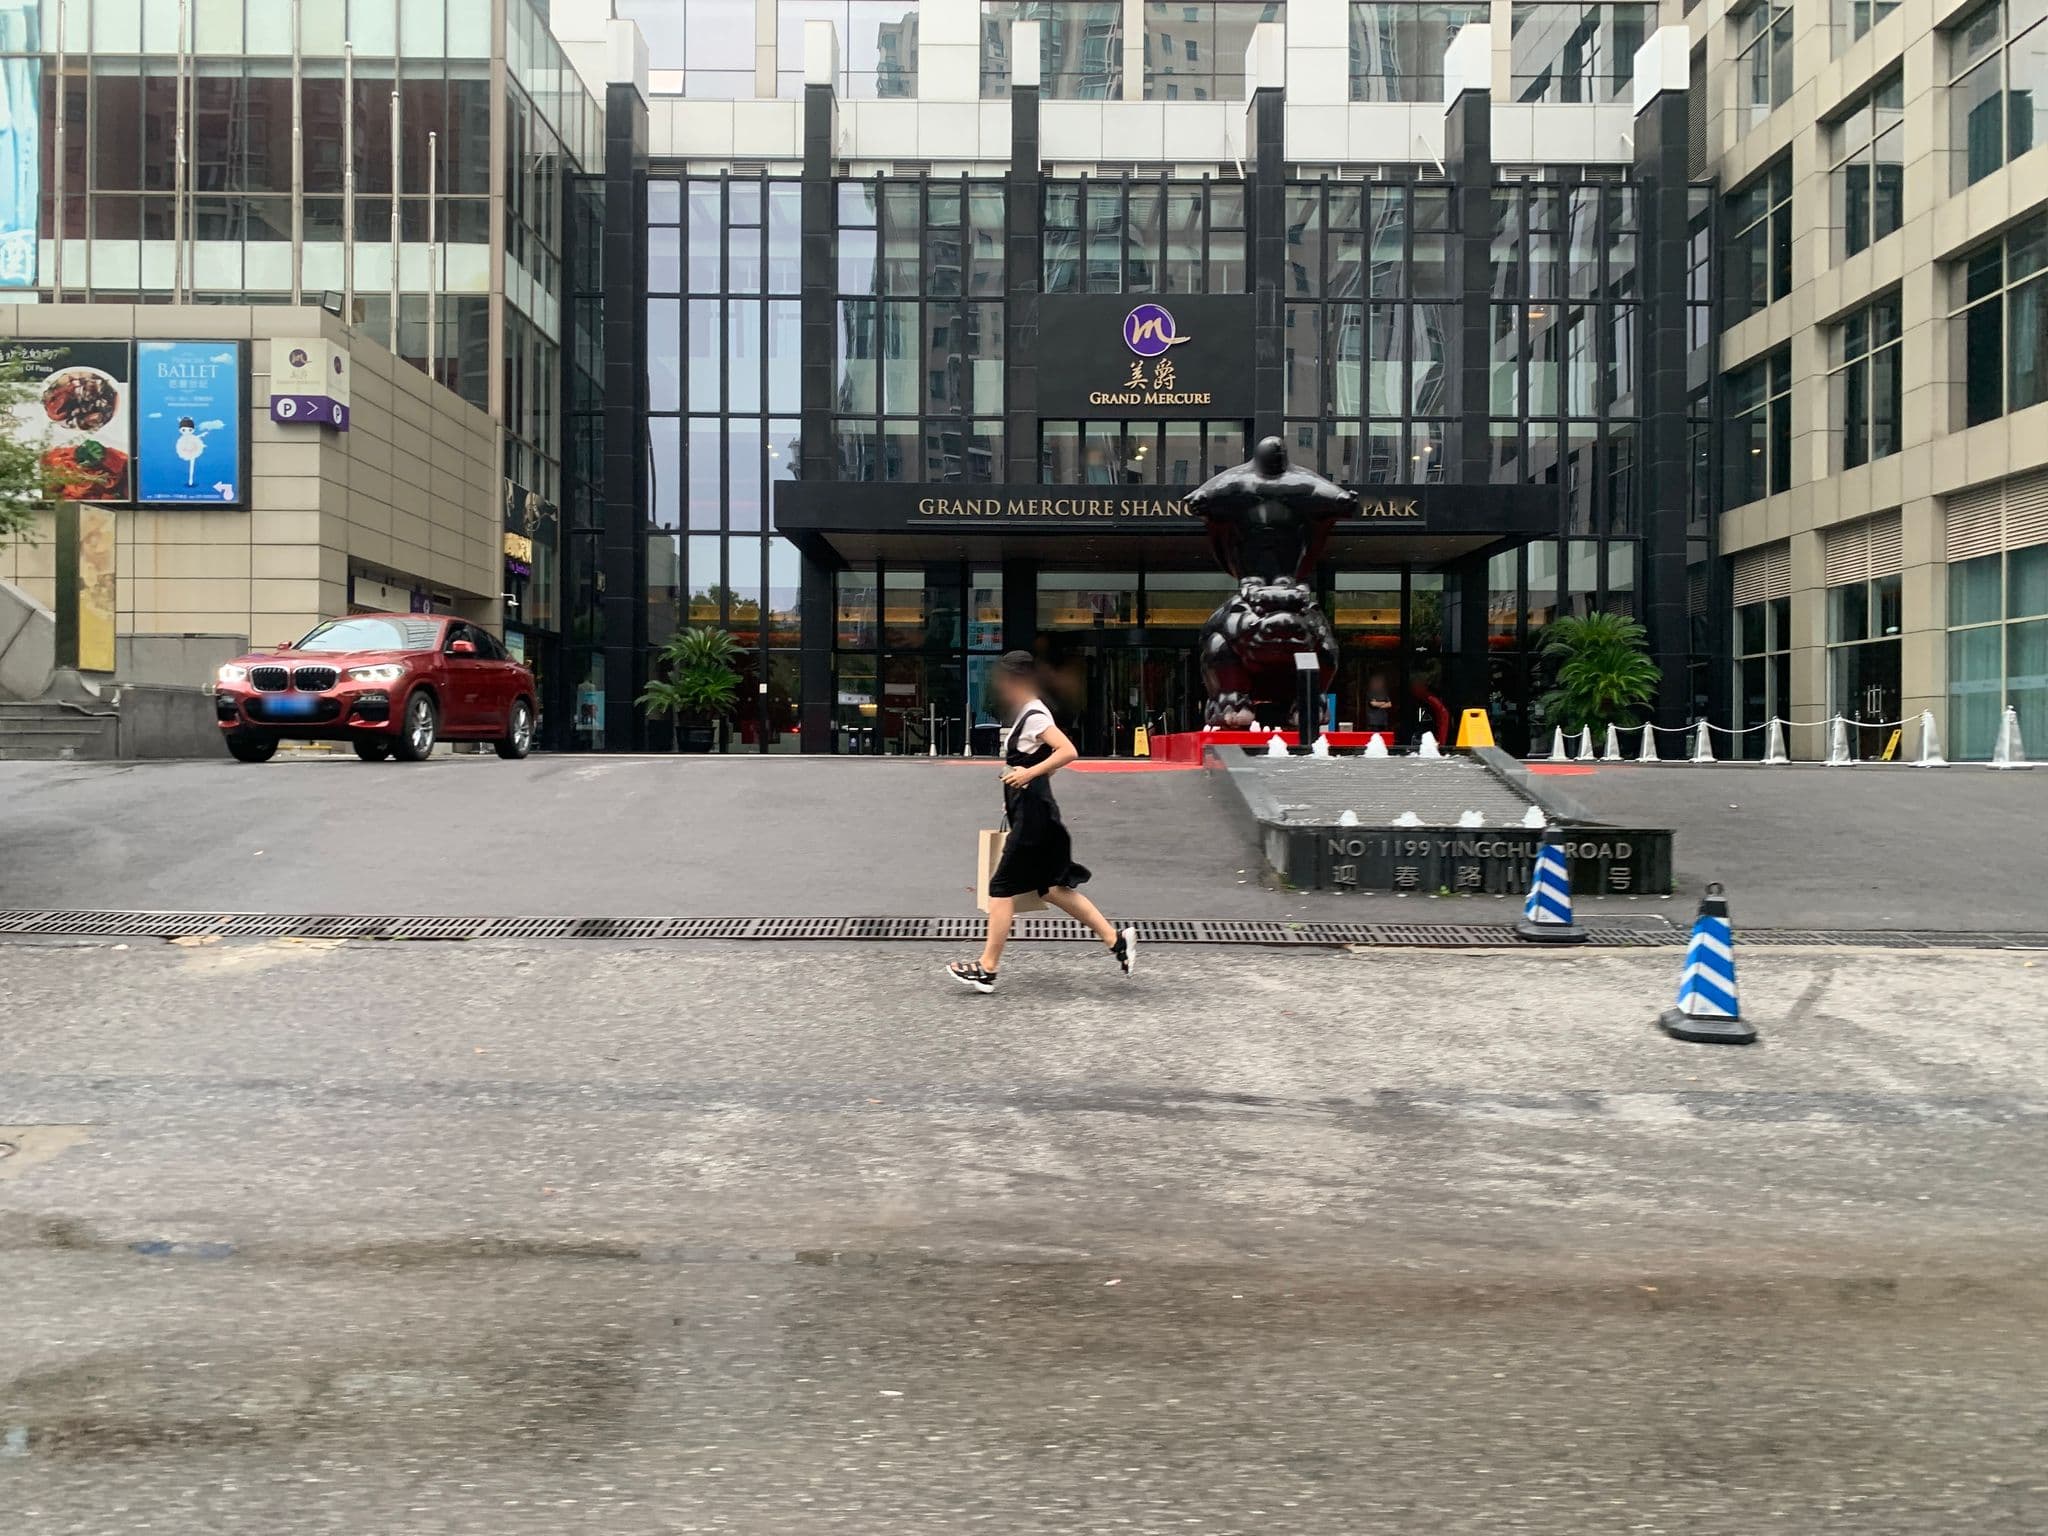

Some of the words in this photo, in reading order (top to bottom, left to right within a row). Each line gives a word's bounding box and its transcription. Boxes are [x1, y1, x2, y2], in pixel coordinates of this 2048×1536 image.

[158, 362, 219, 378] BALLET
[1123, 357, 1177, 390] 美爵
[1089, 391, 1141, 405] GRAND
[1144, 392, 1211, 405] MERCURE
[283, 403, 292, 416] P
[918, 498, 1001, 516] GRAND
[1007, 499, 1114, 516] MERCURE
[1361, 500, 1419, 517] PARK
[1380, 839, 1432, 857] 1199
[1436, 840, 1544, 858] YINGCHU
[1565, 842, 1633, 859] ROAD
